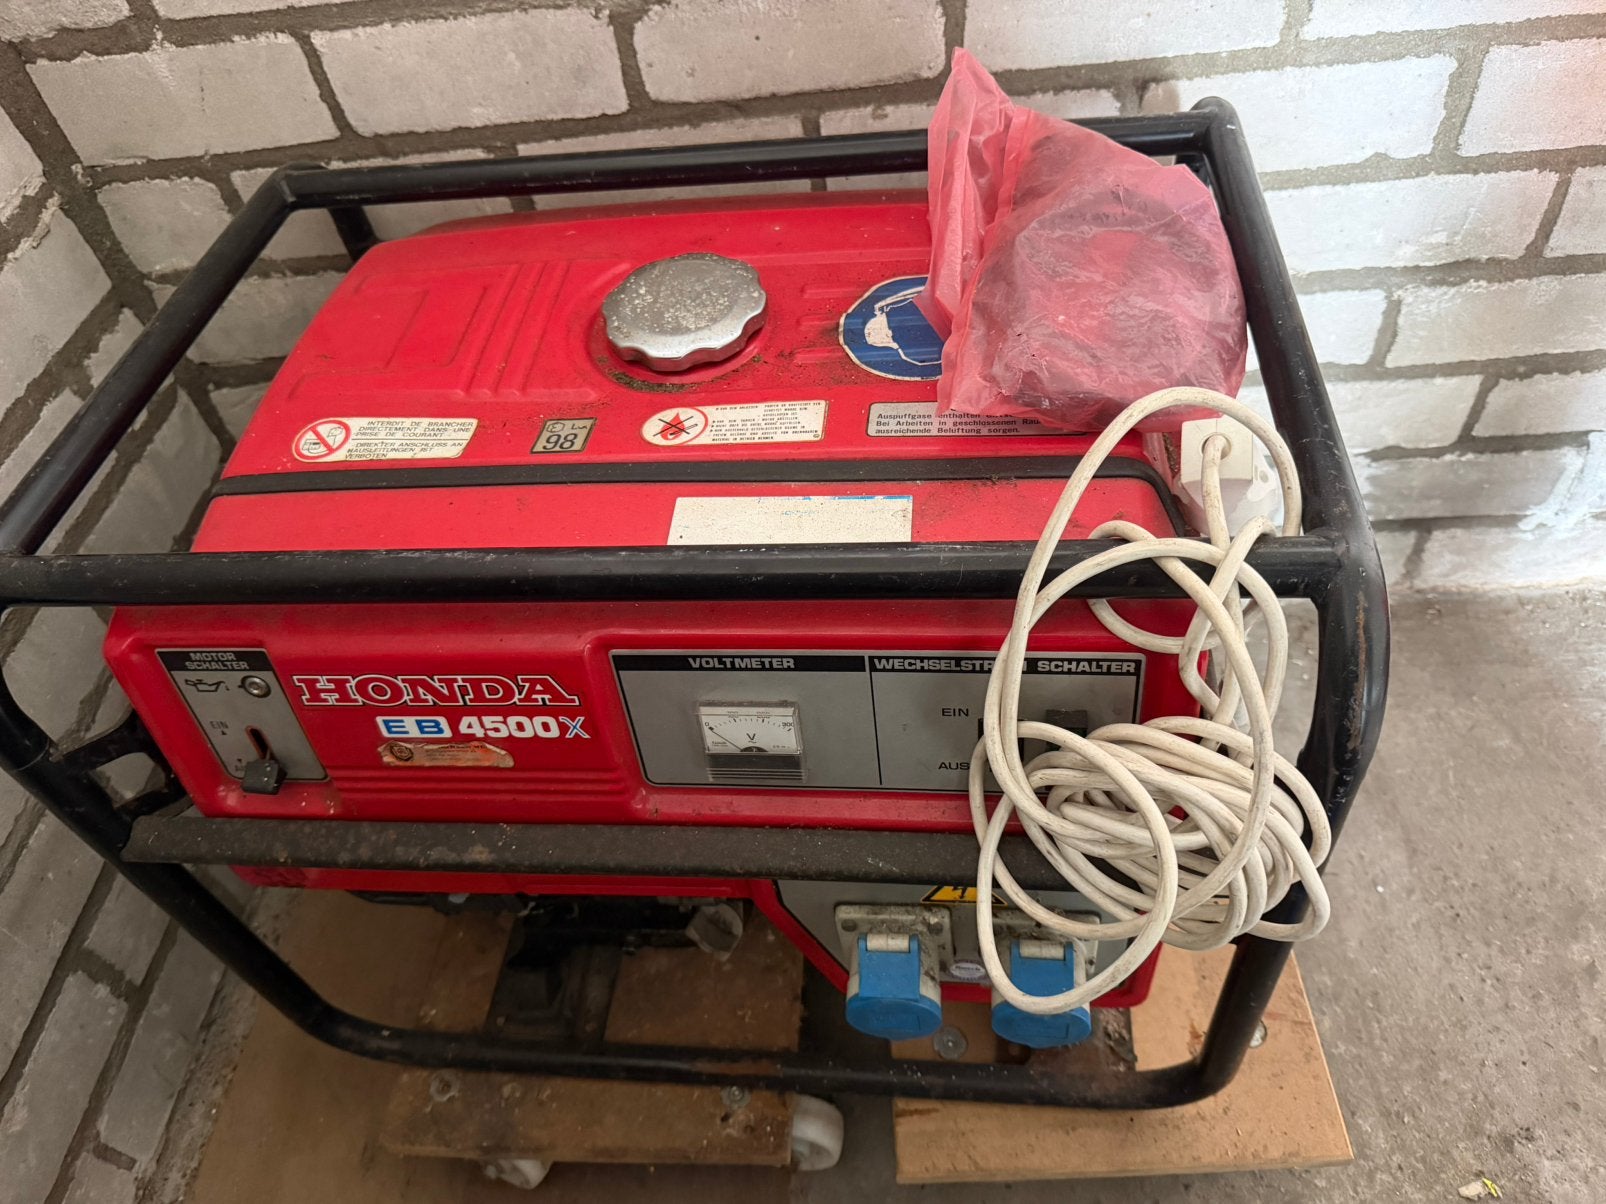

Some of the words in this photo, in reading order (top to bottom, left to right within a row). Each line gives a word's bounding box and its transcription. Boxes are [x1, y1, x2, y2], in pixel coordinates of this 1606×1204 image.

[877, 413, 932, 421] Auspuffgase
[952, 419, 1017, 428] geschlossenen
[1022, 418, 1041, 426] Rau
[542, 433, 578, 450] 98
[189, 652, 236, 661] MOTOR
[184, 661, 250, 670] SCHALTER
[688, 657, 795, 669] VOLTMETER
[874, 658, 1027, 672] WECHSELSTR
[1037, 660, 1135, 673] SCHALTER
[292, 674, 581, 707] HONDA
[941, 707, 970, 717] EIN
[209, 720, 229, 729] EIN
[381, 719, 446, 735] EB
[746, 732, 756, 740] V
[938, 761, 970, 771] AUS
